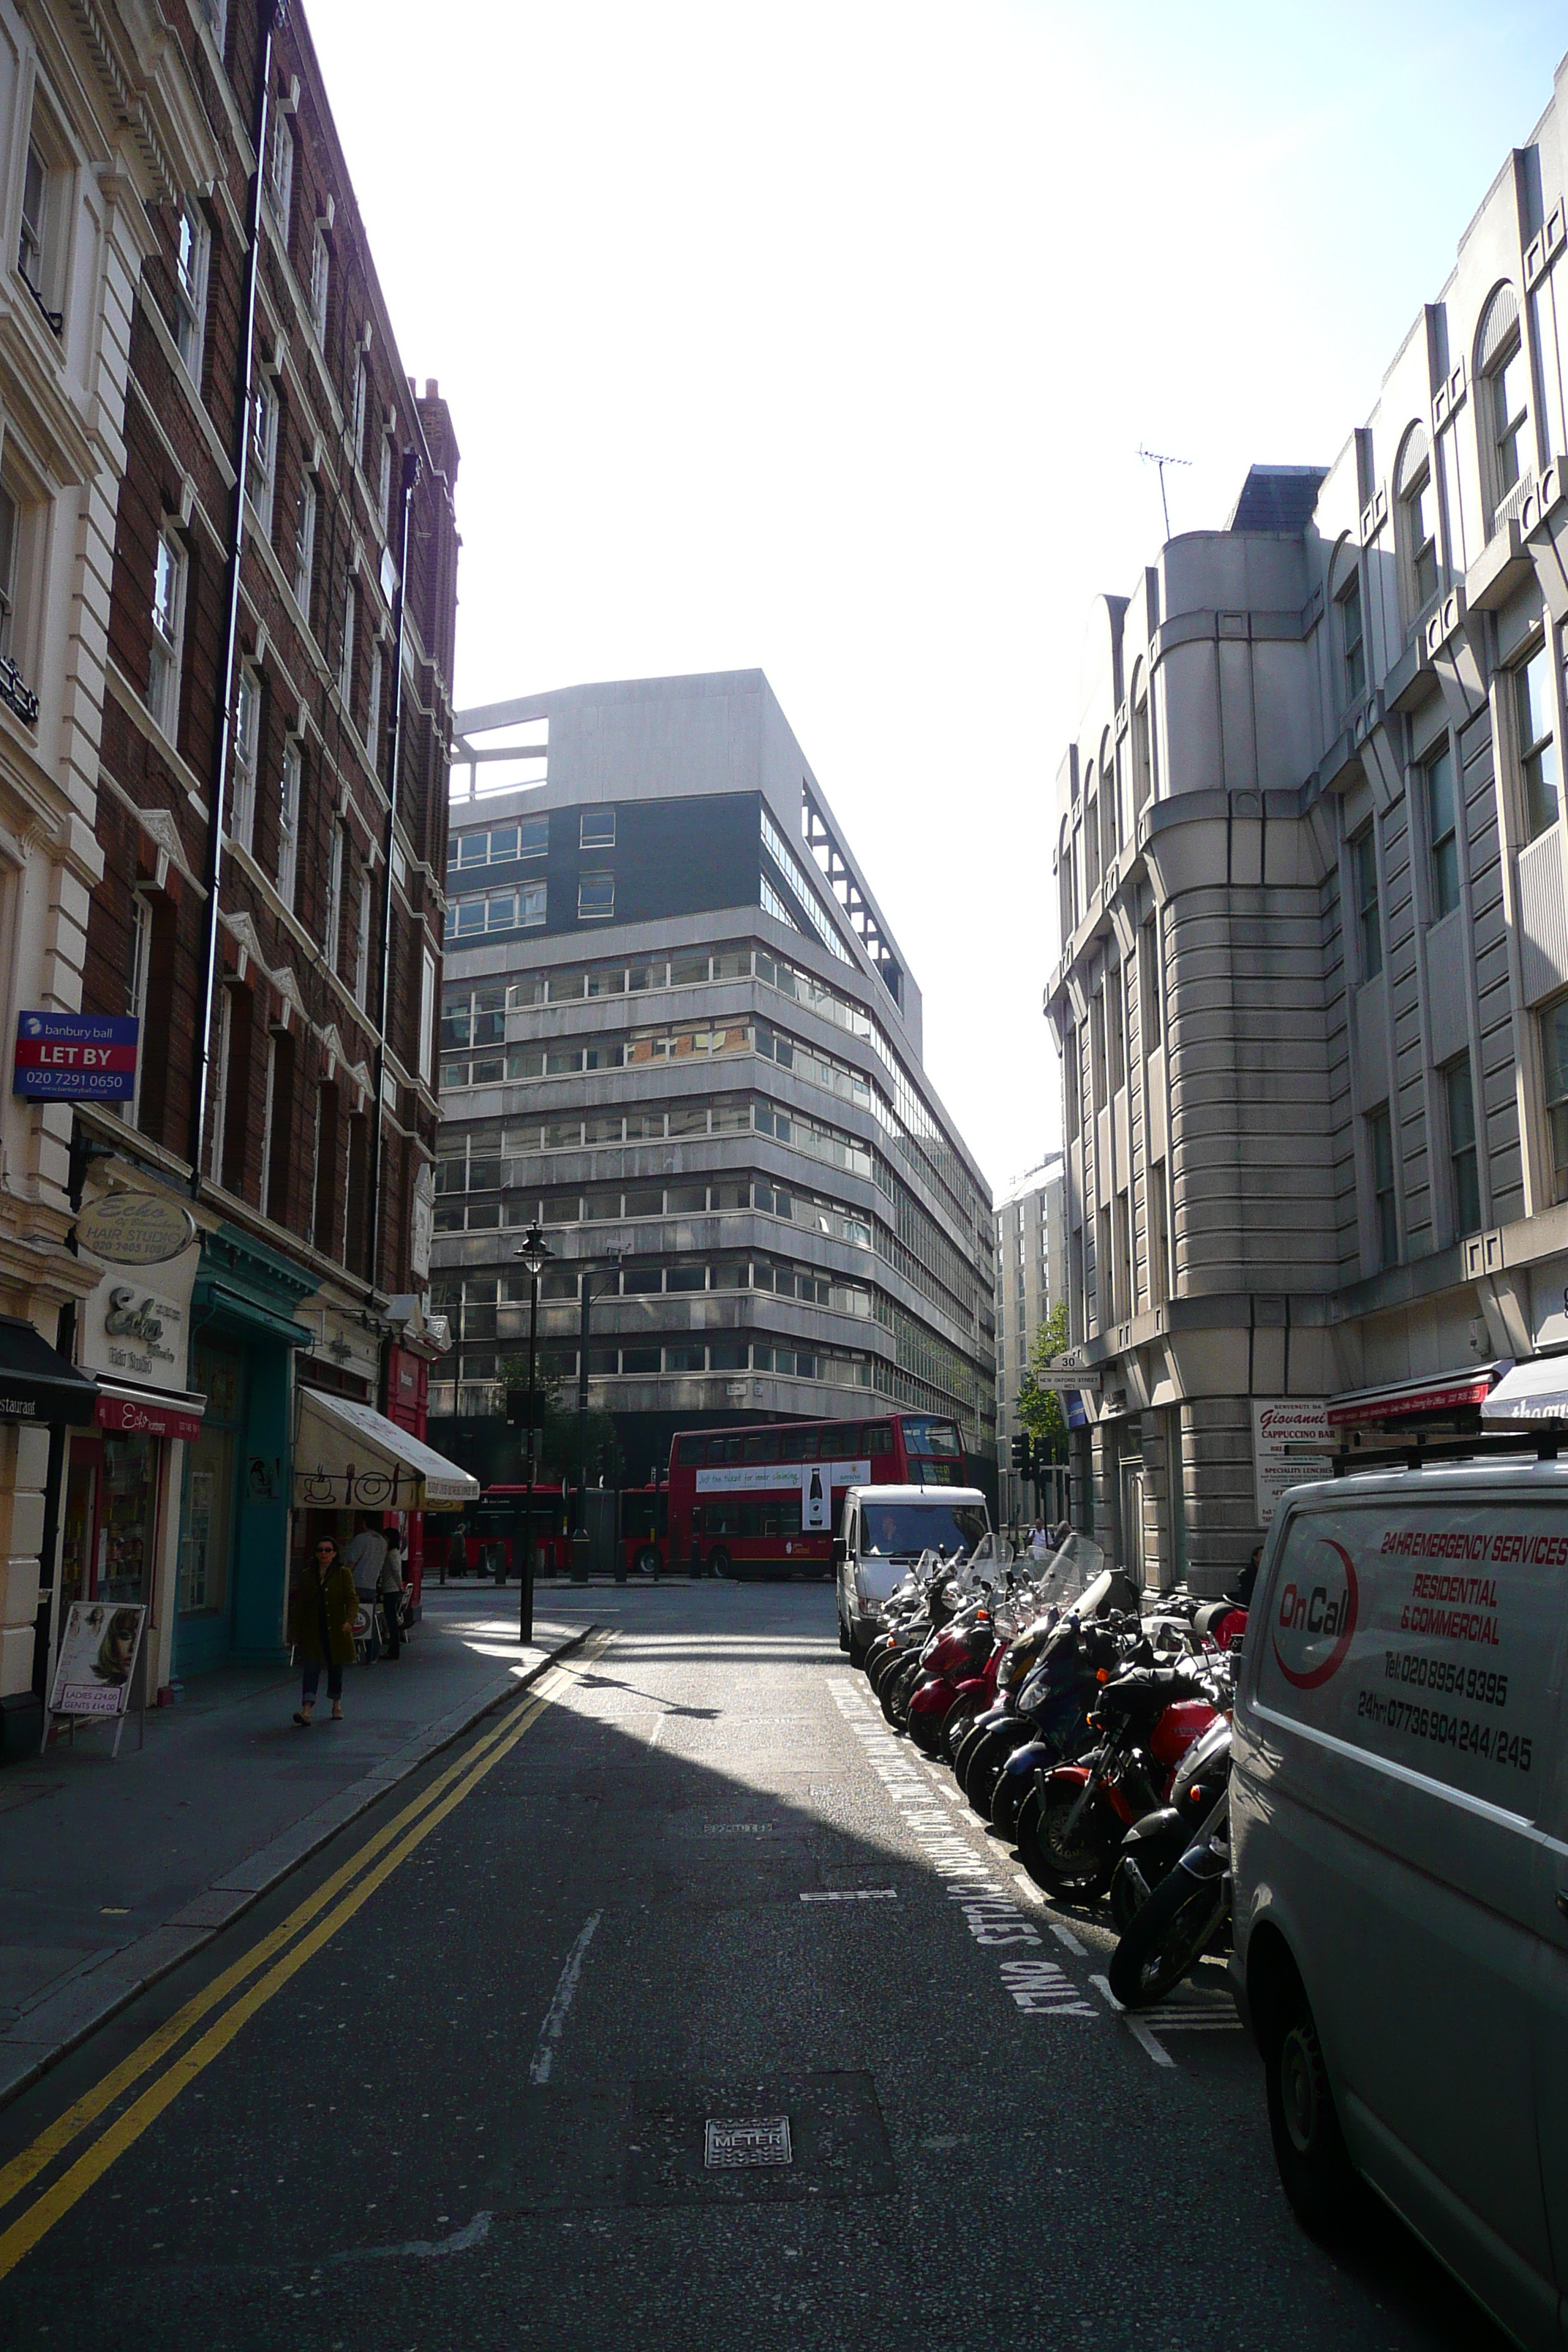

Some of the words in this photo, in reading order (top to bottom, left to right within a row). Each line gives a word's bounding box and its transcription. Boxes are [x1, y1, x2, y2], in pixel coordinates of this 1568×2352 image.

[45, 1025, 91, 1039] banbury
[93, 1028, 113, 1039] ball
[40, 1046, 78, 1064] LET
[83, 1049, 111, 1066] BY
[26, 1071, 51, 1085] 020
[56, 1073, 86, 1086] 7291
[89, 1076, 122, 1088] 0650
[86, 1226, 123, 1240] HAIR
[127, 1229, 181, 1244] STUDIO
[1062, 1357, 1075, 1367] 30
[121, 1403, 149, 1429] Echo
[1259, 1409, 1327, 1431] Giovanni
[1262, 1431, 1316, 1439] CAPPUCCINO
[1318, 1431, 1336, 1439] BAR
[712, 1474, 723, 1483] the
[724, 1472, 742, 1482] ticket
[744, 1471, 753, 1483] for
[1381, 1532, 1395, 1554] 24
[1396, 1533, 1414, 1556] HR
[1413, 1534, 1491, 1561] EMERGENCY
[1491, 1535, 1568, 1567] SERVICES
[1413, 1573, 1498, 1607] RESIDENTIAL
[1401, 1605, 1410, 1630] &
[1411, 1607, 1500, 1646] COMMERCIAL
[1385, 1651, 1400, 1679] Tel:
[1401, 1655, 1426, 1684] 020
[1428, 1660, 1466, 1695] 8954
[1466, 1668, 1509, 1707] 9395
[64, 1701, 90, 1709] GENTS
[92, 1703, 115, 1711] £14.00
[66, 1691, 92, 1700] LADIES
[94, 1693, 117, 1701] £24.00
[1358, 1690, 1388, 1724] 24hr:
[1387, 1699, 1429, 1738] 07736
[1429, 1711, 1458, 1746] 904
[1458, 1720, 1532, 1771] 244/245
[884, 1783, 939, 1803] ONLY
[900, 1809, 957, 1832] SOLO
[916, 1837, 990, 1877] MOTOR
[946, 1883, 1044, 1946] CYCLES
[999, 1960, 1101, 2017] ONLY
[715, 2134, 781, 2148] METER
